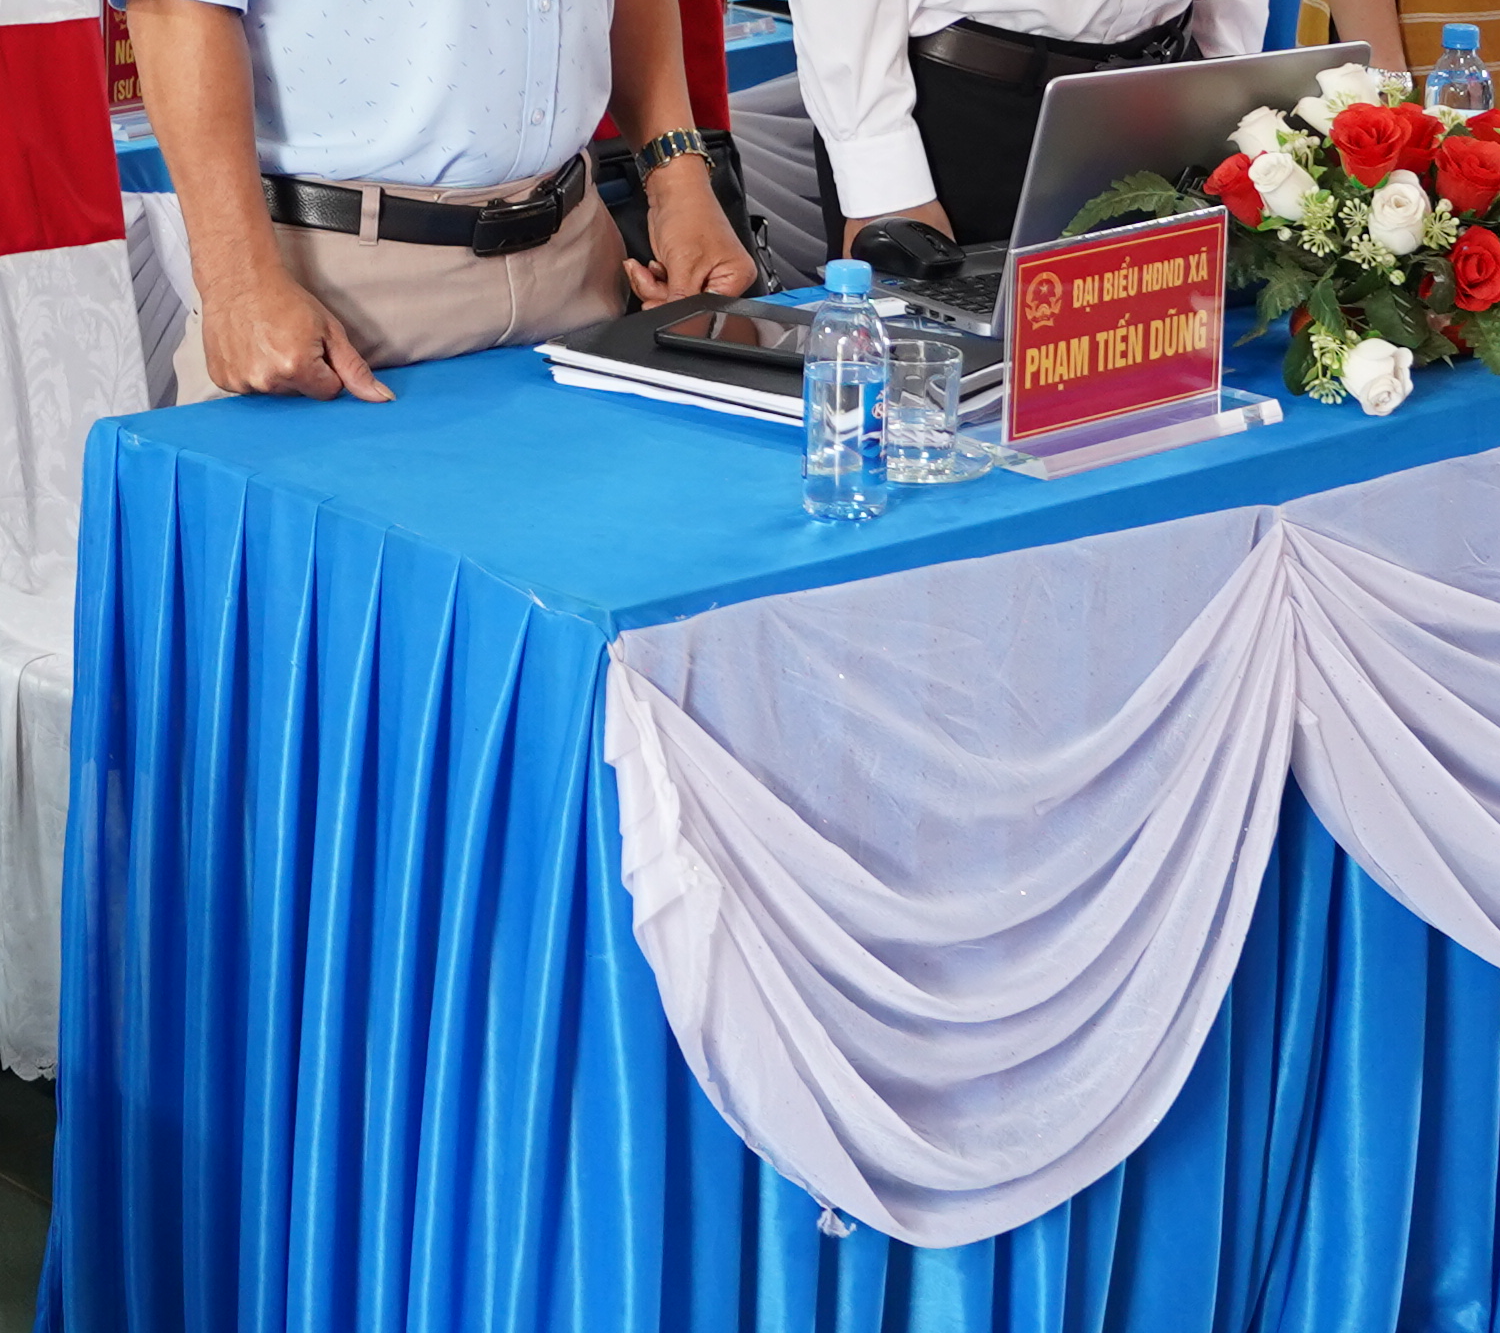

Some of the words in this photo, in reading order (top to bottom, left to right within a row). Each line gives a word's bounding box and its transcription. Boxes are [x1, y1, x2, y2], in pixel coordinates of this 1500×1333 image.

[1072, 275, 1100, 312] ĐẠI
[1103, 256, 1137, 303] BIỂU
[1142, 257, 1184, 294] HĐND
[1188, 248, 1208, 284] XÃ
[1025, 335, 1089, 391] PHẠM
[1096, 313, 1143, 374] TIẾN
[1149, 307, 1207, 362] DŨNG
